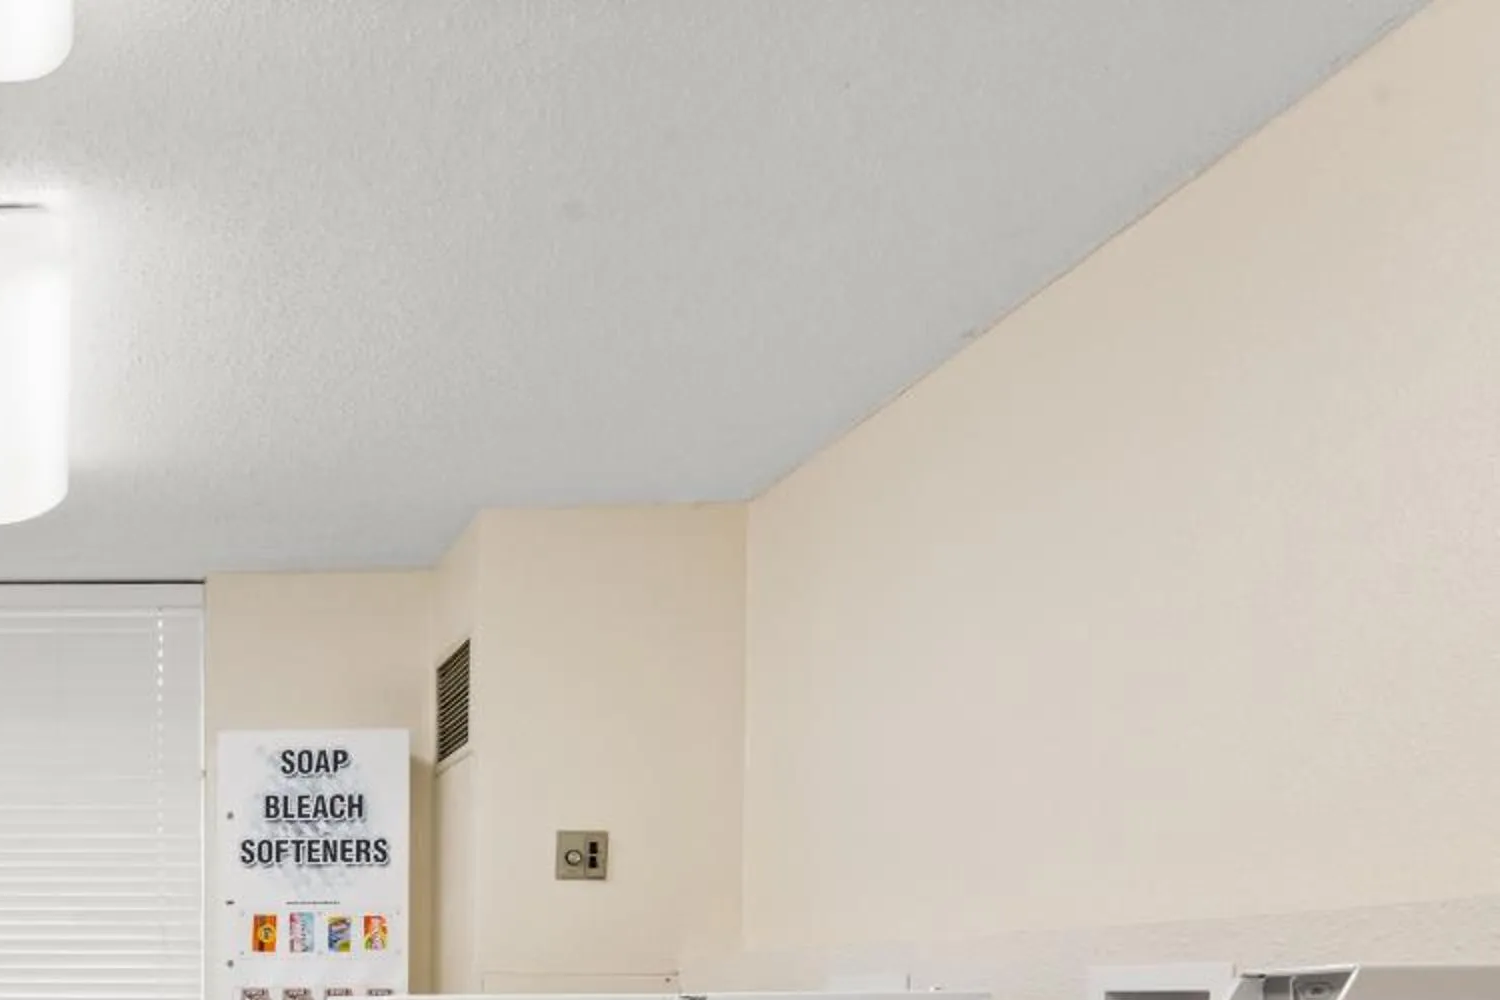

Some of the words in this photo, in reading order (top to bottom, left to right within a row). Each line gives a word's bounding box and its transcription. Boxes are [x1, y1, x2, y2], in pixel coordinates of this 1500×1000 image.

[281, 749, 349, 774] SOAP
[264, 794, 364, 818] BLEACH
[240, 838, 388, 864] SOFTENERS
